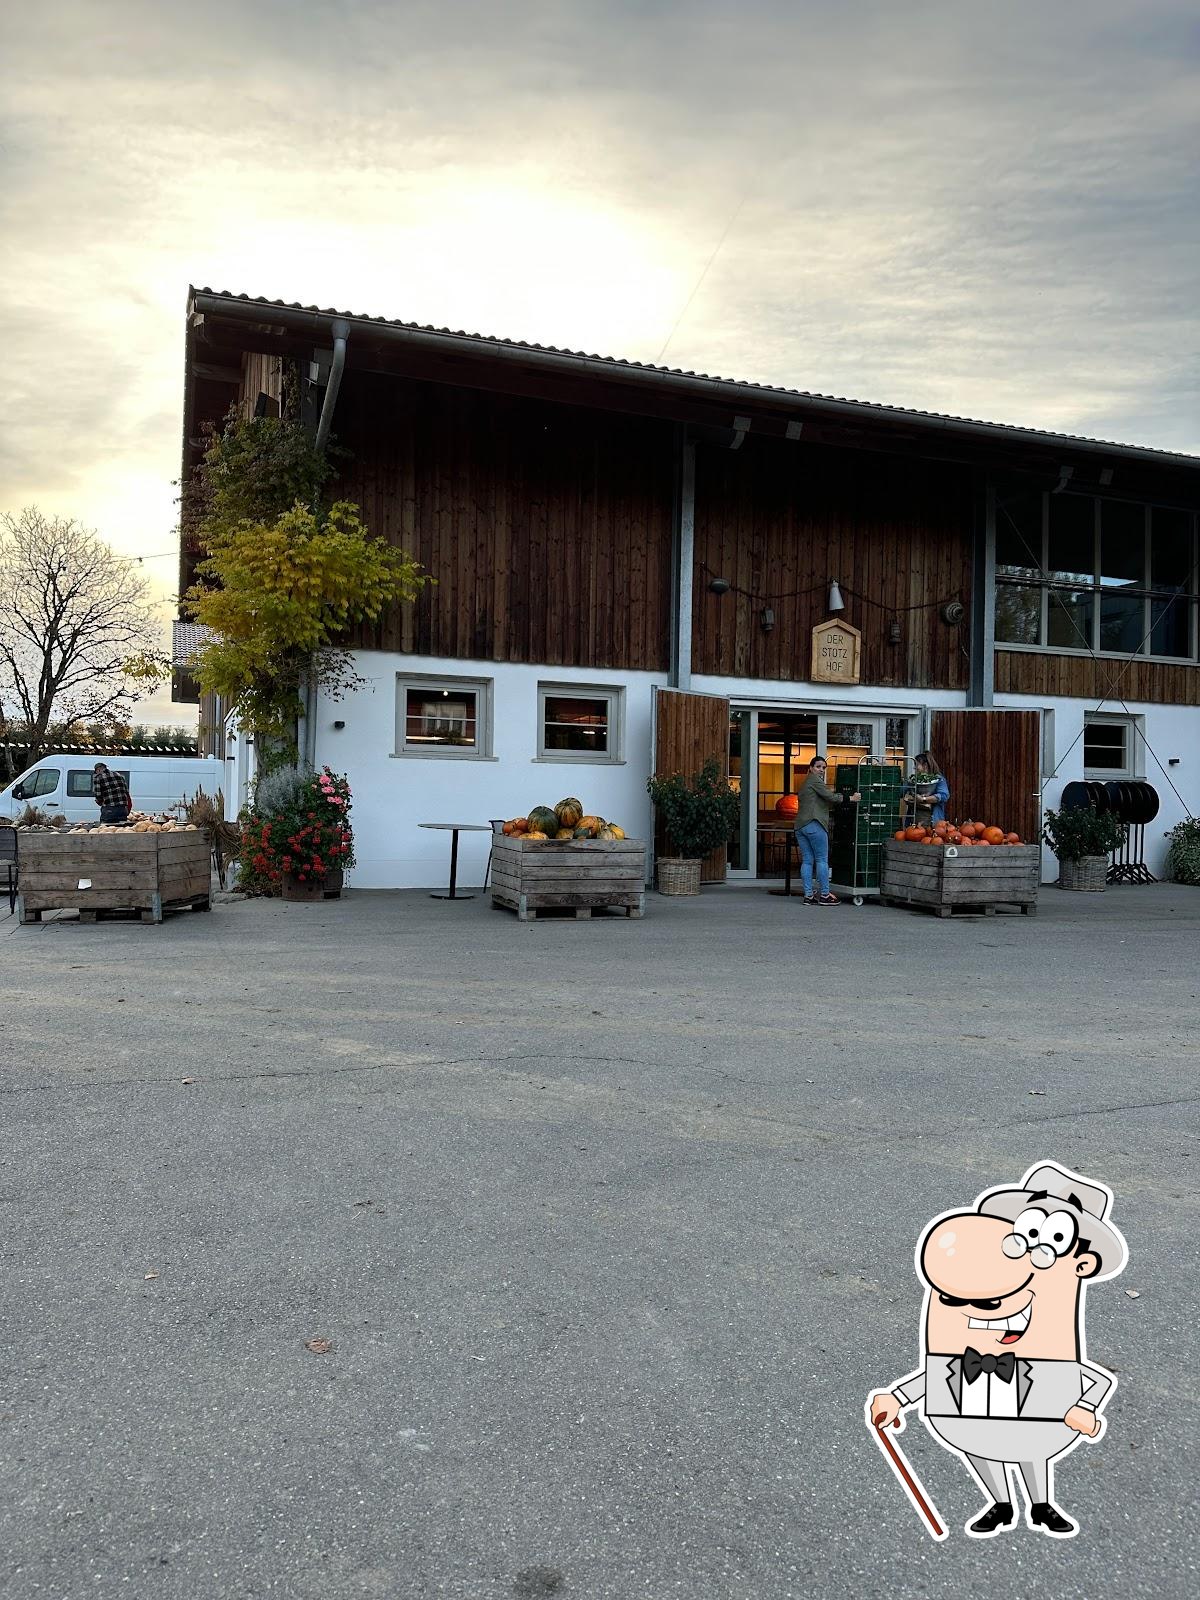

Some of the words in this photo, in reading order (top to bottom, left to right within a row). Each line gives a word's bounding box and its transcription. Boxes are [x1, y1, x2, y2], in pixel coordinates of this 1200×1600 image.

[827, 634, 844, 645] DER
[822, 647, 848, 659] STOTZ
[826, 661, 843, 671] HOF
